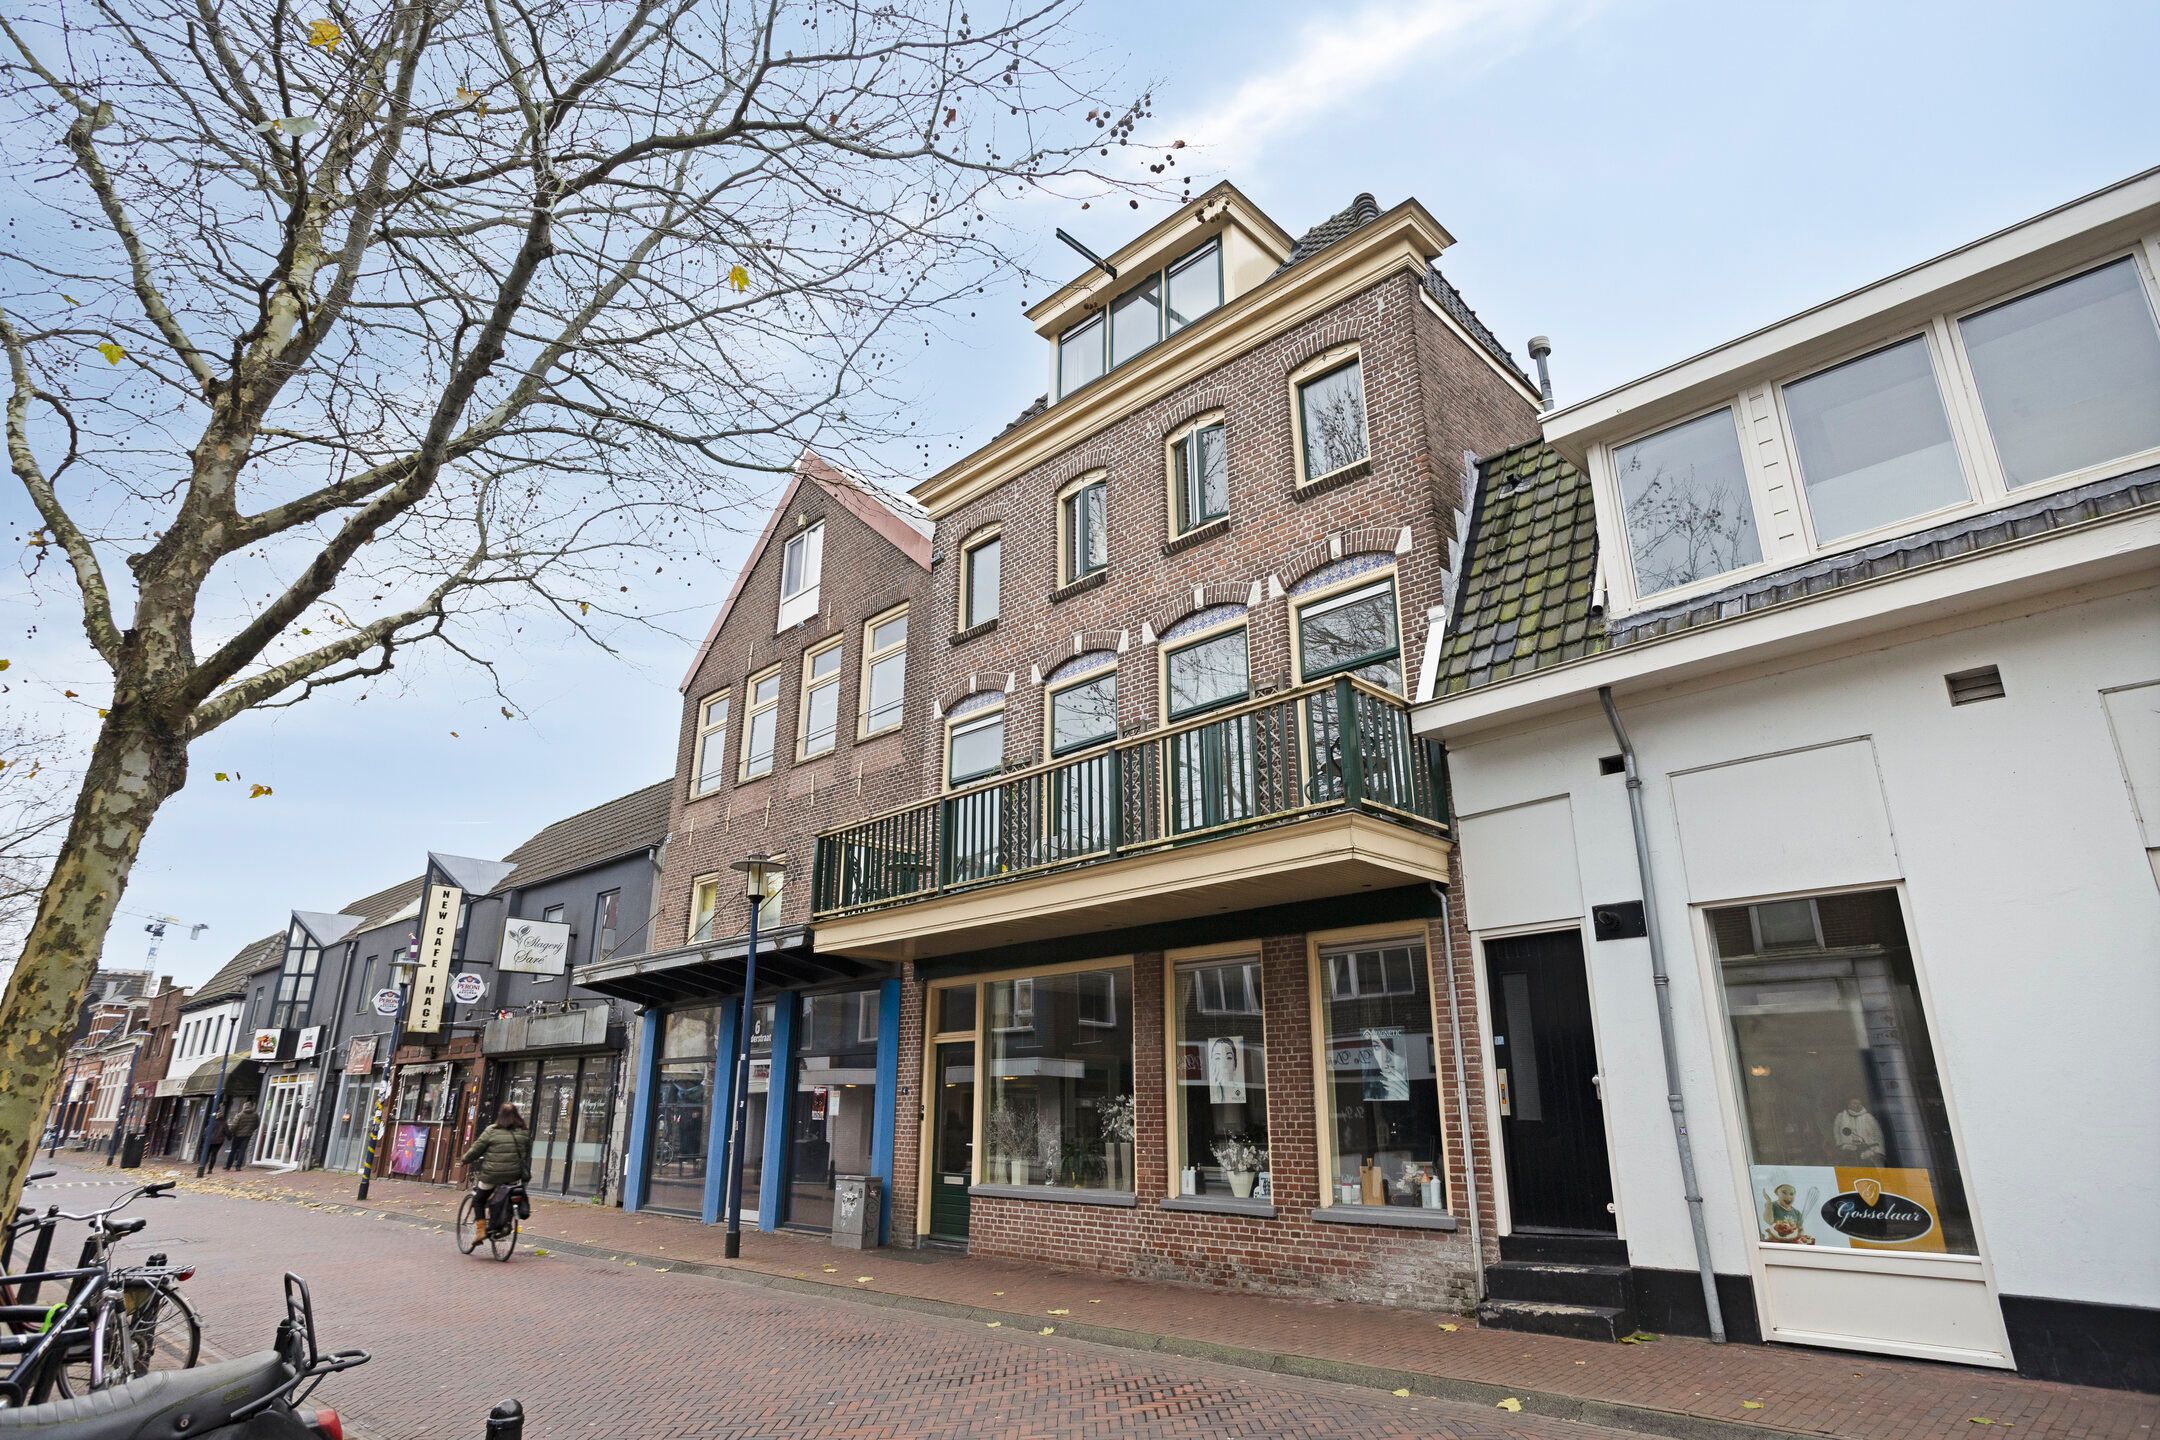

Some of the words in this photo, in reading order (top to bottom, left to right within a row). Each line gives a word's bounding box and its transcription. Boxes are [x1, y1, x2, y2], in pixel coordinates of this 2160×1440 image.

[438, 890, 451, 920] NEW
[431, 926, 444, 968] CAFE
[524, 936, 565, 955] Slagerij
[421, 975, 435, 1029] IMAGE
[750, 1033, 772, 1043] derstraat
[1833, 1201, 1921, 1229] Gosselaar
